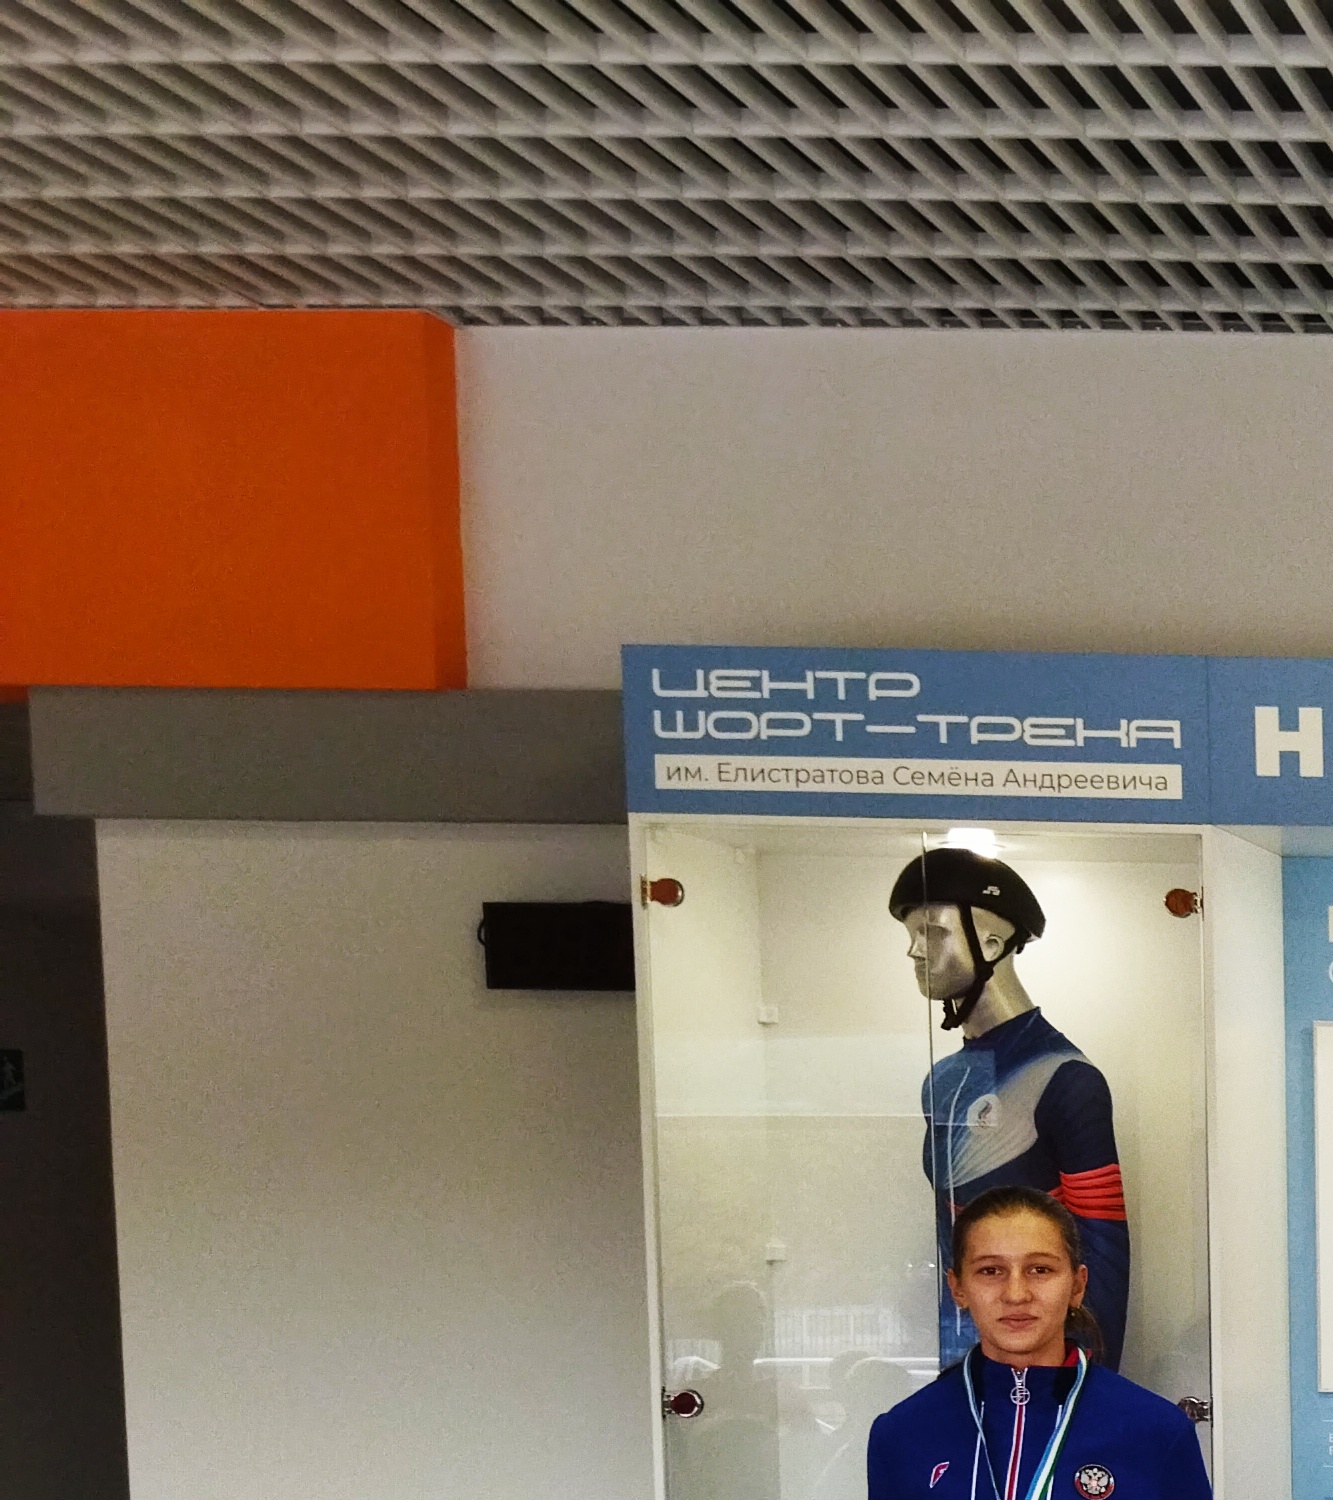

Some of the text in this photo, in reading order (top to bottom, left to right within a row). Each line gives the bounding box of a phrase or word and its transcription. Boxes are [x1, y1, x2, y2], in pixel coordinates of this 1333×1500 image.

[652, 668, 920, 700] ЦЕНТР
[666, 763, 1169, 792] им. Елистратова Семёна Андреевича
